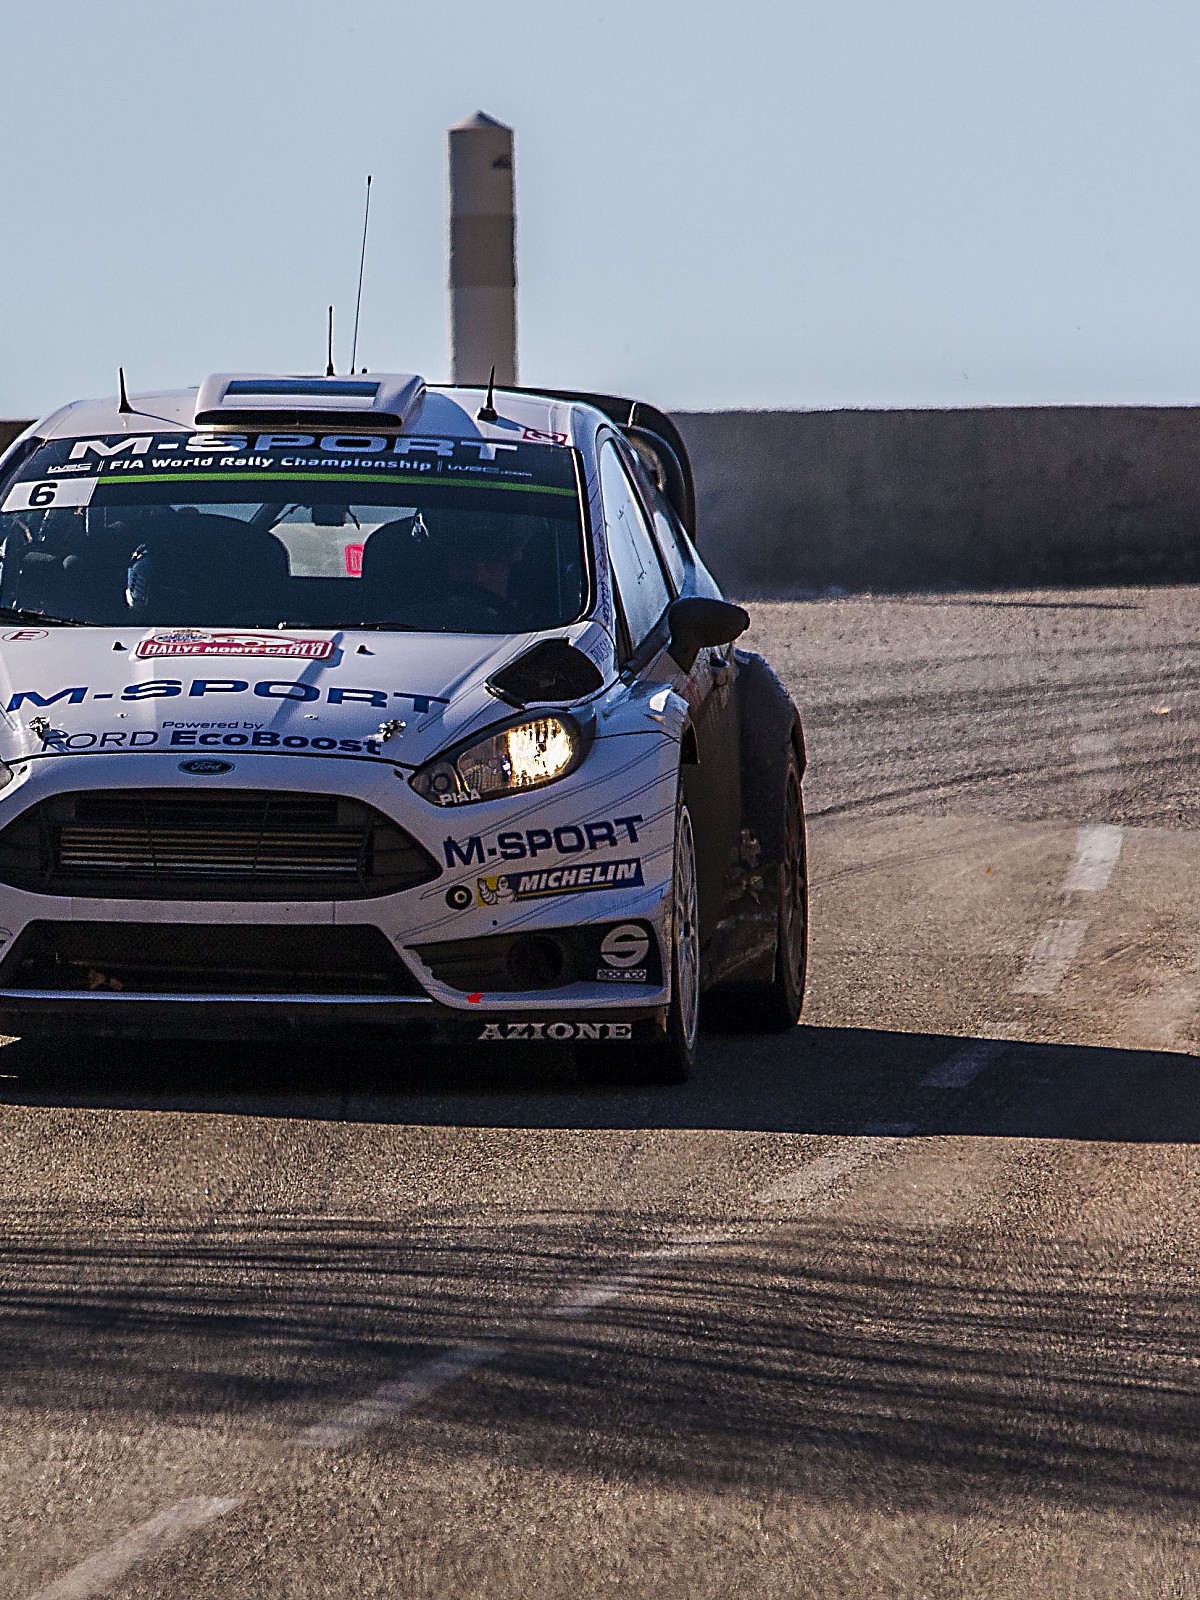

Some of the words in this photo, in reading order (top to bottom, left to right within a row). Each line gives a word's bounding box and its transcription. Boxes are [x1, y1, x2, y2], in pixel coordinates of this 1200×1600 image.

[68, 434, 518, 461] M-SPORT
[109, 459, 144, 470] FIA
[151, 457, 214, 468] World
[219, 456, 274, 468] Rally
[281, 457, 432, 472] Championship
[28, 482, 58, 507] 6
[145, 643, 201, 655] RALLYE
[204, 645, 257, 654] MONTE
[5, 679, 451, 714] M-SPORT
[162, 721, 239, 730] Powered
[243, 721, 264, 731] by
[41, 730, 159, 752] FORD
[169, 730, 382, 756] EcoBoost
[438, 788, 481, 806] PIAA
[443, 814, 644, 869] M-SPORT
[518, 860, 637, 893] MICHELIN
[477, 1022, 632, 1040] AZIONE
